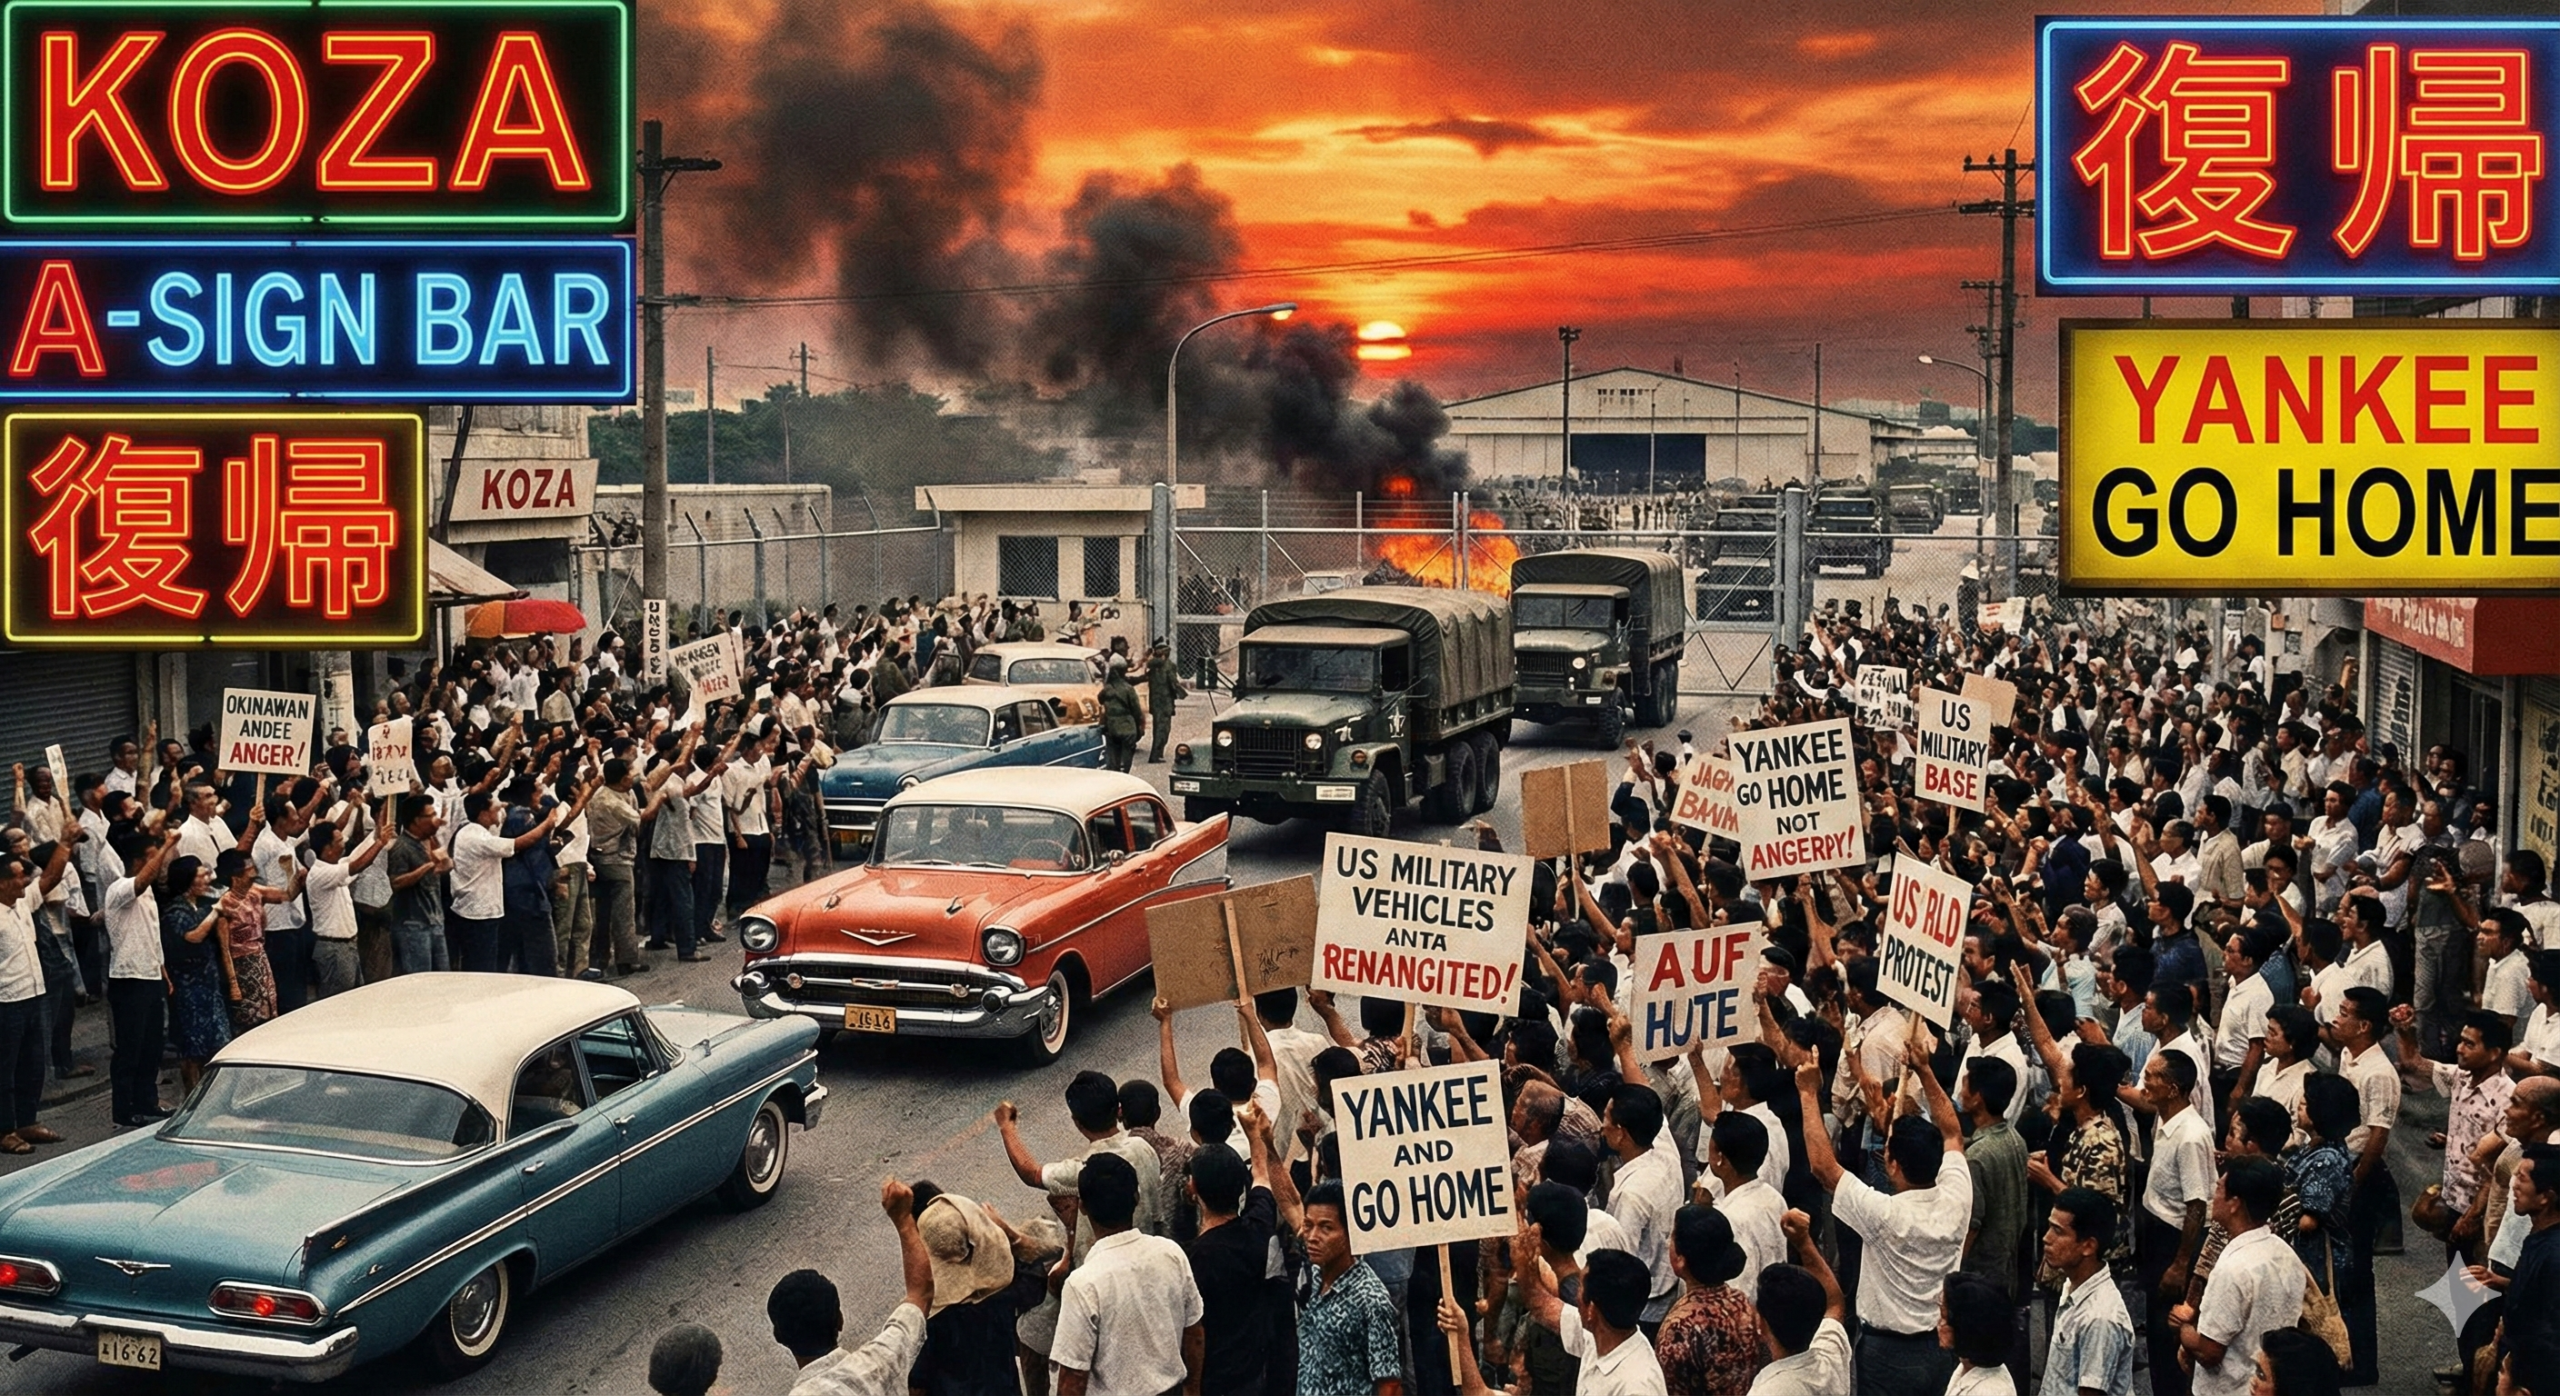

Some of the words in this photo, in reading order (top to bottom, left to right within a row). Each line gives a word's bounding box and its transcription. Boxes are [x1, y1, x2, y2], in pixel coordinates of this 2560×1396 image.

[41, 26, 592, 194] KOZA
[2074, 40, 2544, 262] 復帰
[9, 260, 376, 377] A-SIGN
[416, 271, 611, 366] BAR
[2114, 356, 2540, 444] YANKEE
[482, 468, 575, 510] KOZA
[2092, 466, 2238, 557] GO
[2278, 466, 2560, 557] HOME
[28, 433, 397, 621] 復帰
[226, 695, 309, 720] OKINAWAN
[239, 719, 292, 739] ANDEE
[1940, 699, 1971, 731] US
[229, 741, 306, 767] ANGER!
[1734, 728, 1847, 773] YANKEE
[1921, 731, 1988, 769] MILITARY
[1736, 783, 1762, 806] GO
[1768, 768, 1847, 809] HOME
[1924, 763, 1978, 801] BASE
[1776, 811, 1821, 835] NOT
[1337, 846, 1379, 880] US
[1391, 853, 1517, 896] MILITARY
[1750, 825, 1856, 871] ANGERPY!
[1353, 886, 1495, 932] VEHICLES
[1893, 872, 1921, 930] US
[1385, 927, 1447, 951] ANTA
[1323, 943, 1518, 1004] RENANGITED!
[1882, 933, 1955, 1008] PROTEST
[1645, 987, 1740, 1051] HUTE
[1341, 1074, 1493, 1140] YANKEE
[1393, 1139, 1454, 1167] AND
[1352, 1178, 1400, 1232] GO
[1409, 1165, 1508, 1224] HOME
